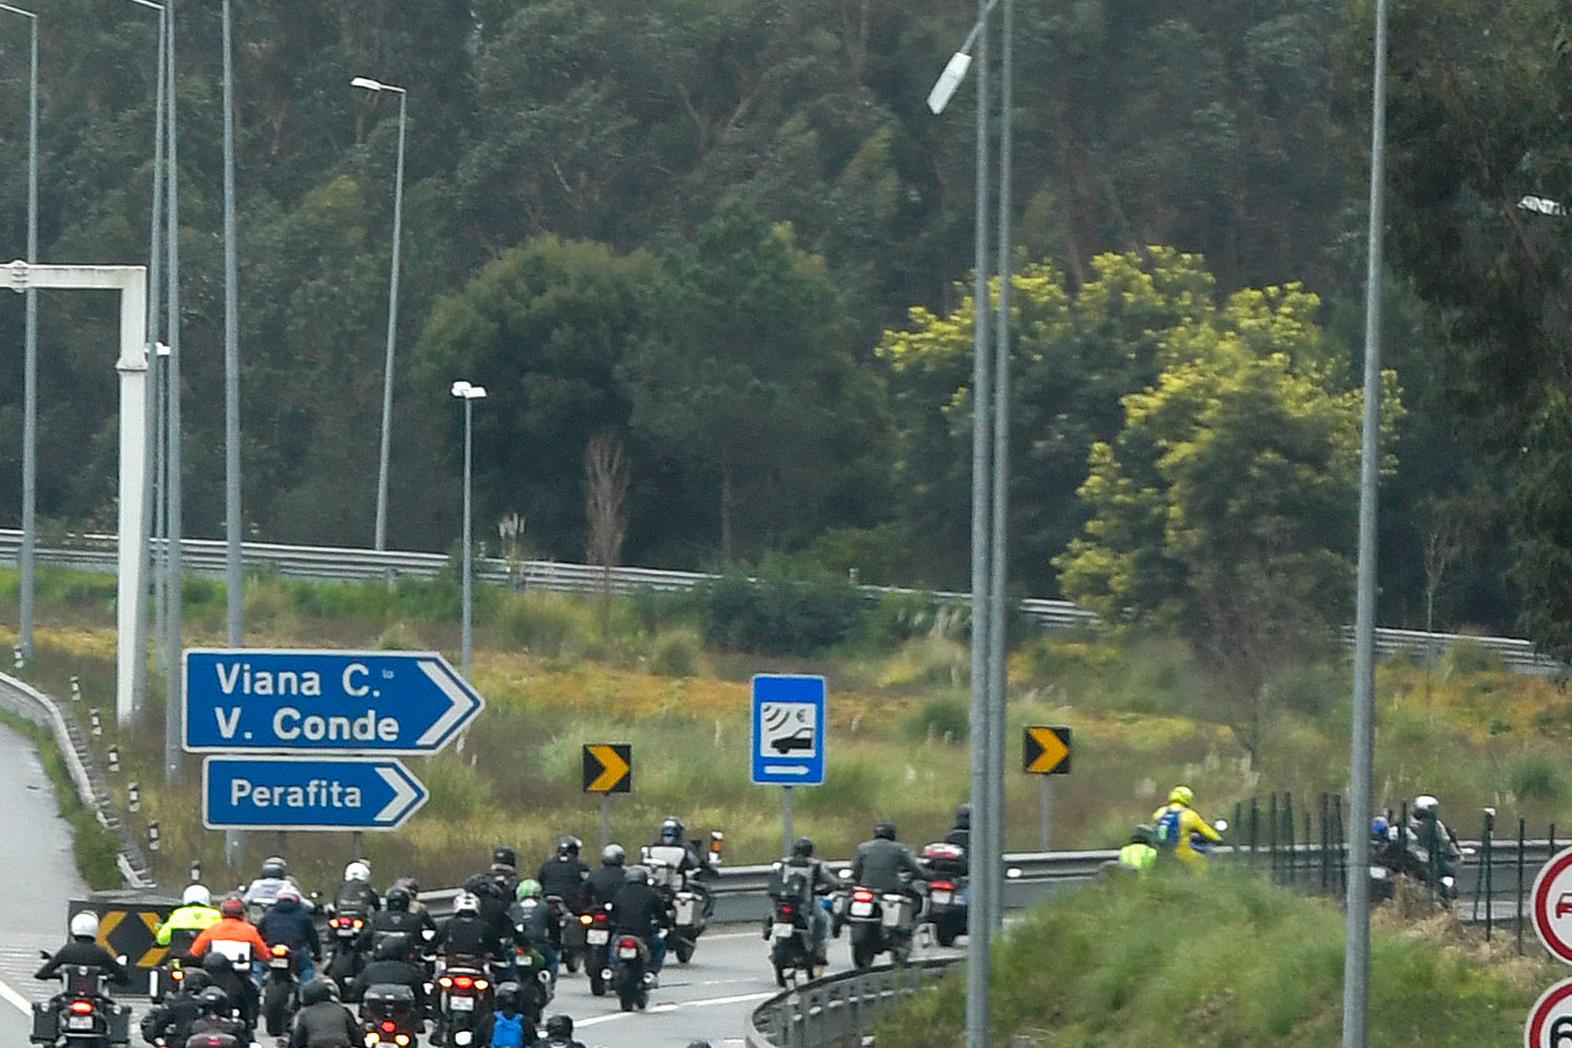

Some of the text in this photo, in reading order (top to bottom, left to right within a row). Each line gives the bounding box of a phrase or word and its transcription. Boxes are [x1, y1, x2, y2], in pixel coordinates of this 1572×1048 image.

[216, 662, 321, 696] Viana
[214, 706, 400, 742] V. Conde
[231, 778, 362, 808] Perafita
